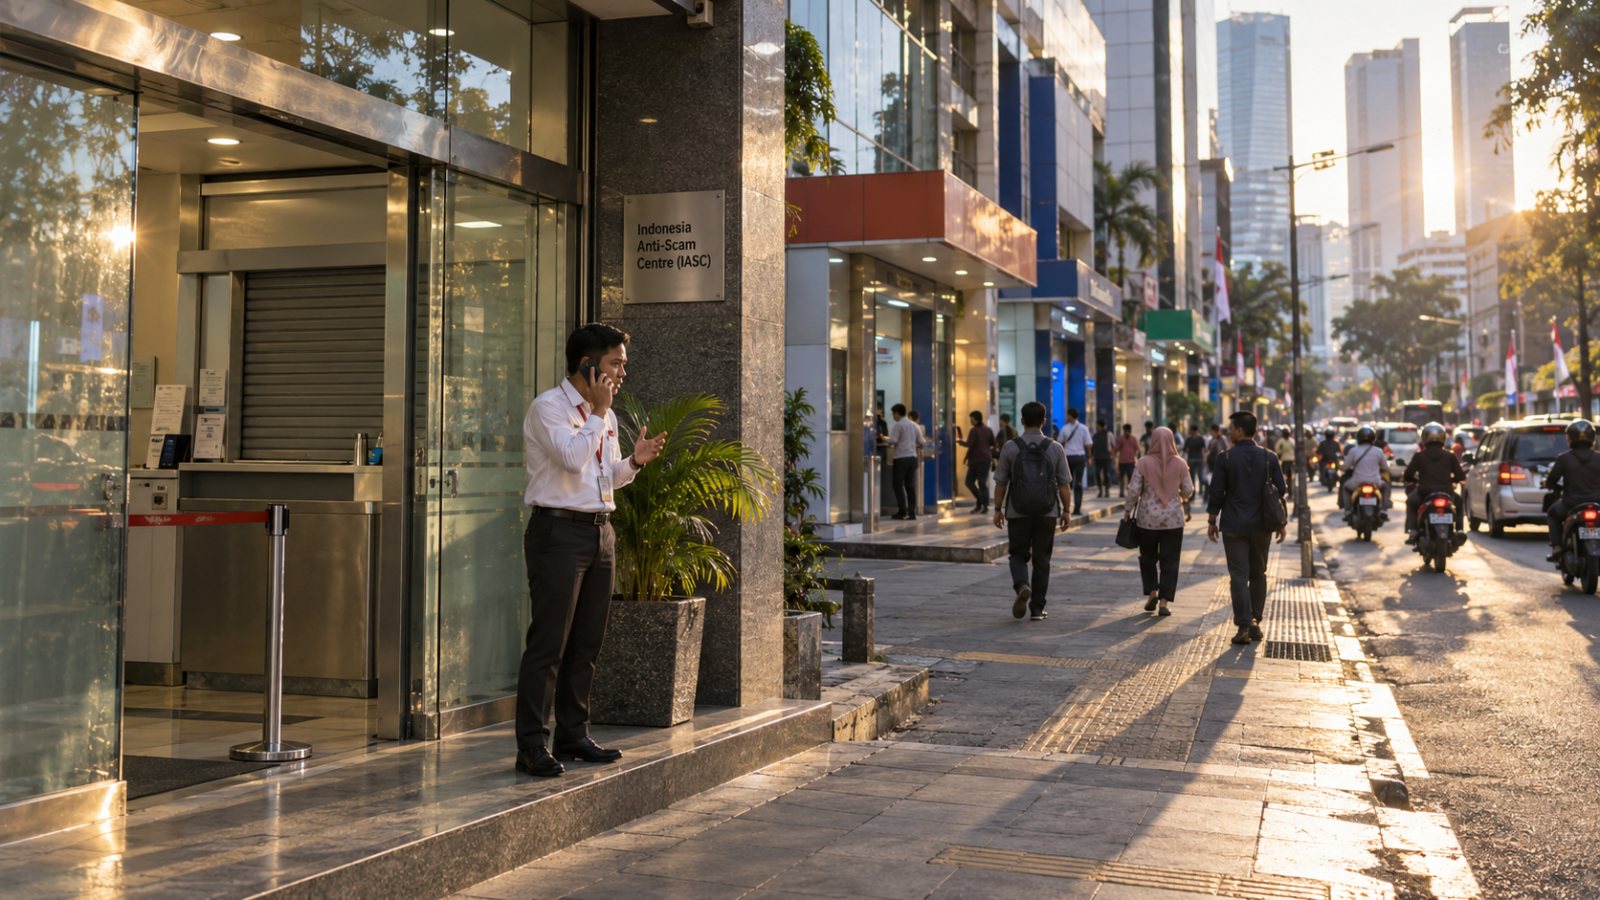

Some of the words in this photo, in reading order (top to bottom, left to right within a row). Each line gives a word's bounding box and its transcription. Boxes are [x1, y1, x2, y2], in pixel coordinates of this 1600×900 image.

[638, 221, 691, 235] Indonesia
[637, 238, 696, 252] Anti-Scam
[637, 257, 673, 269] Centre
[677, 255, 711, 269] (IASC)
